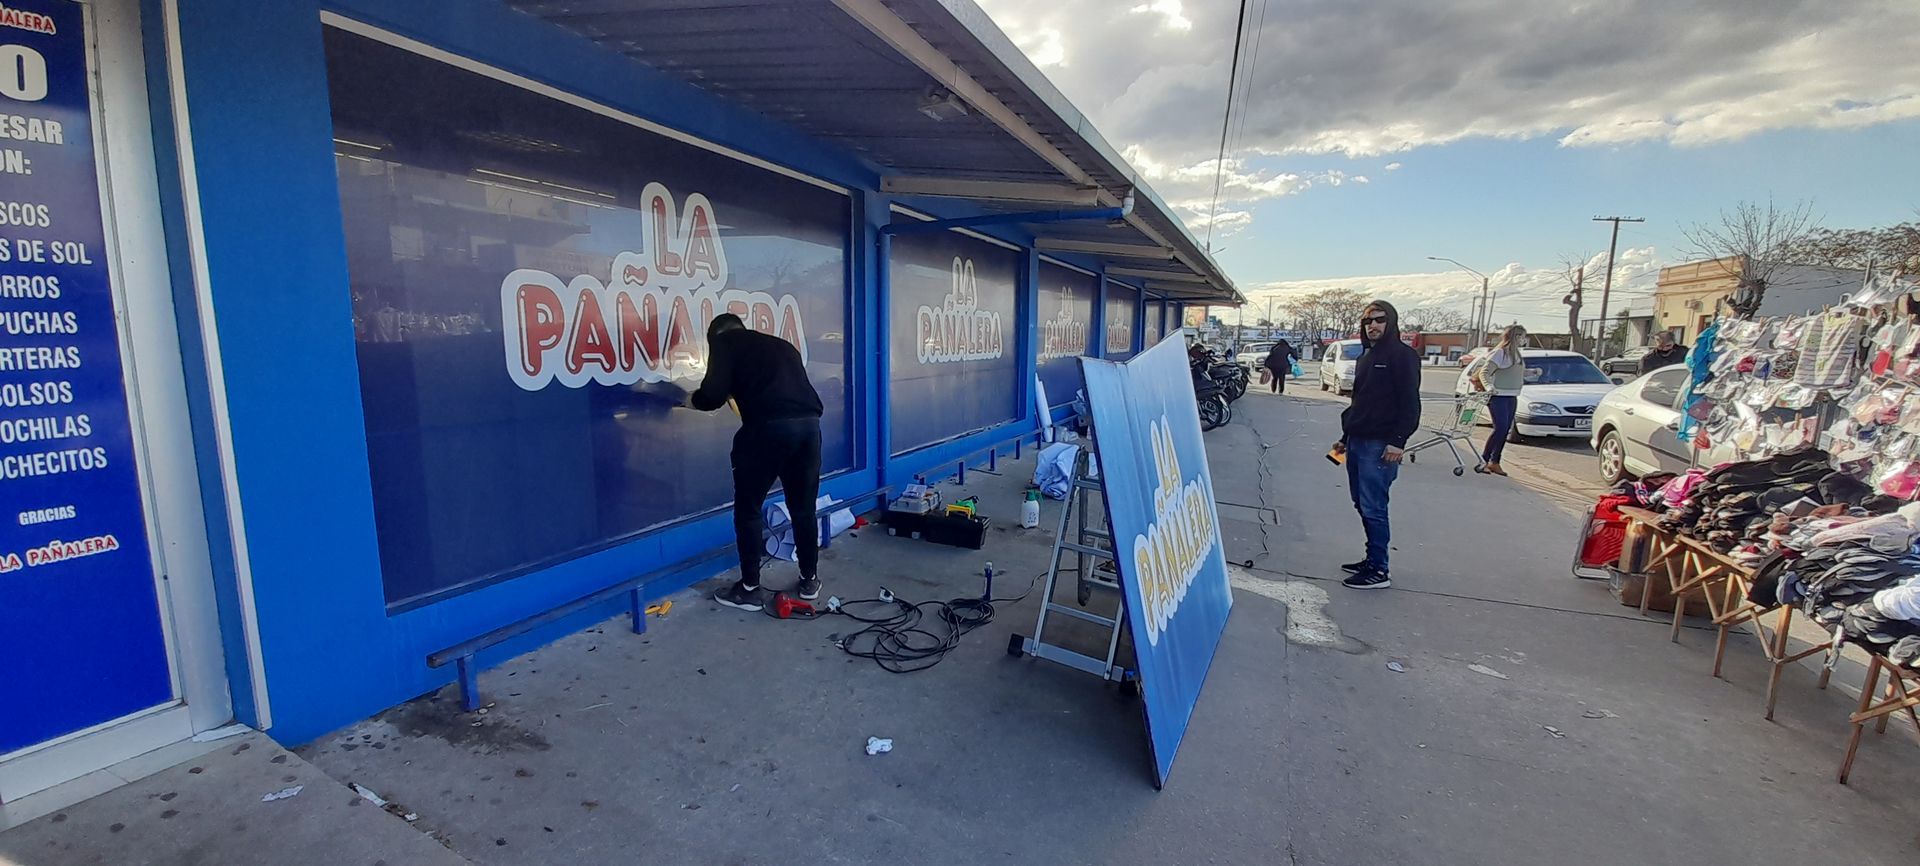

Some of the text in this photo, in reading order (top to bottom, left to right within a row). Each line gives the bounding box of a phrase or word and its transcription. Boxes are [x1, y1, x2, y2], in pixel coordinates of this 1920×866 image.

[0, 114, 63, 145] ESAR
[17, 240, 46, 263] DE
[51, 241, 92, 265] SOL
[651, 195, 720, 280] LA
[0, 275, 61, 299] RROS
[955, 262, 974, 307] LA
[0, 381, 73, 408] OLSOS
[1153, 424, 1181, 500] LA
[18, 504, 77, 526] GRACIAS
[28, 536, 117, 566] PAÑALERA
